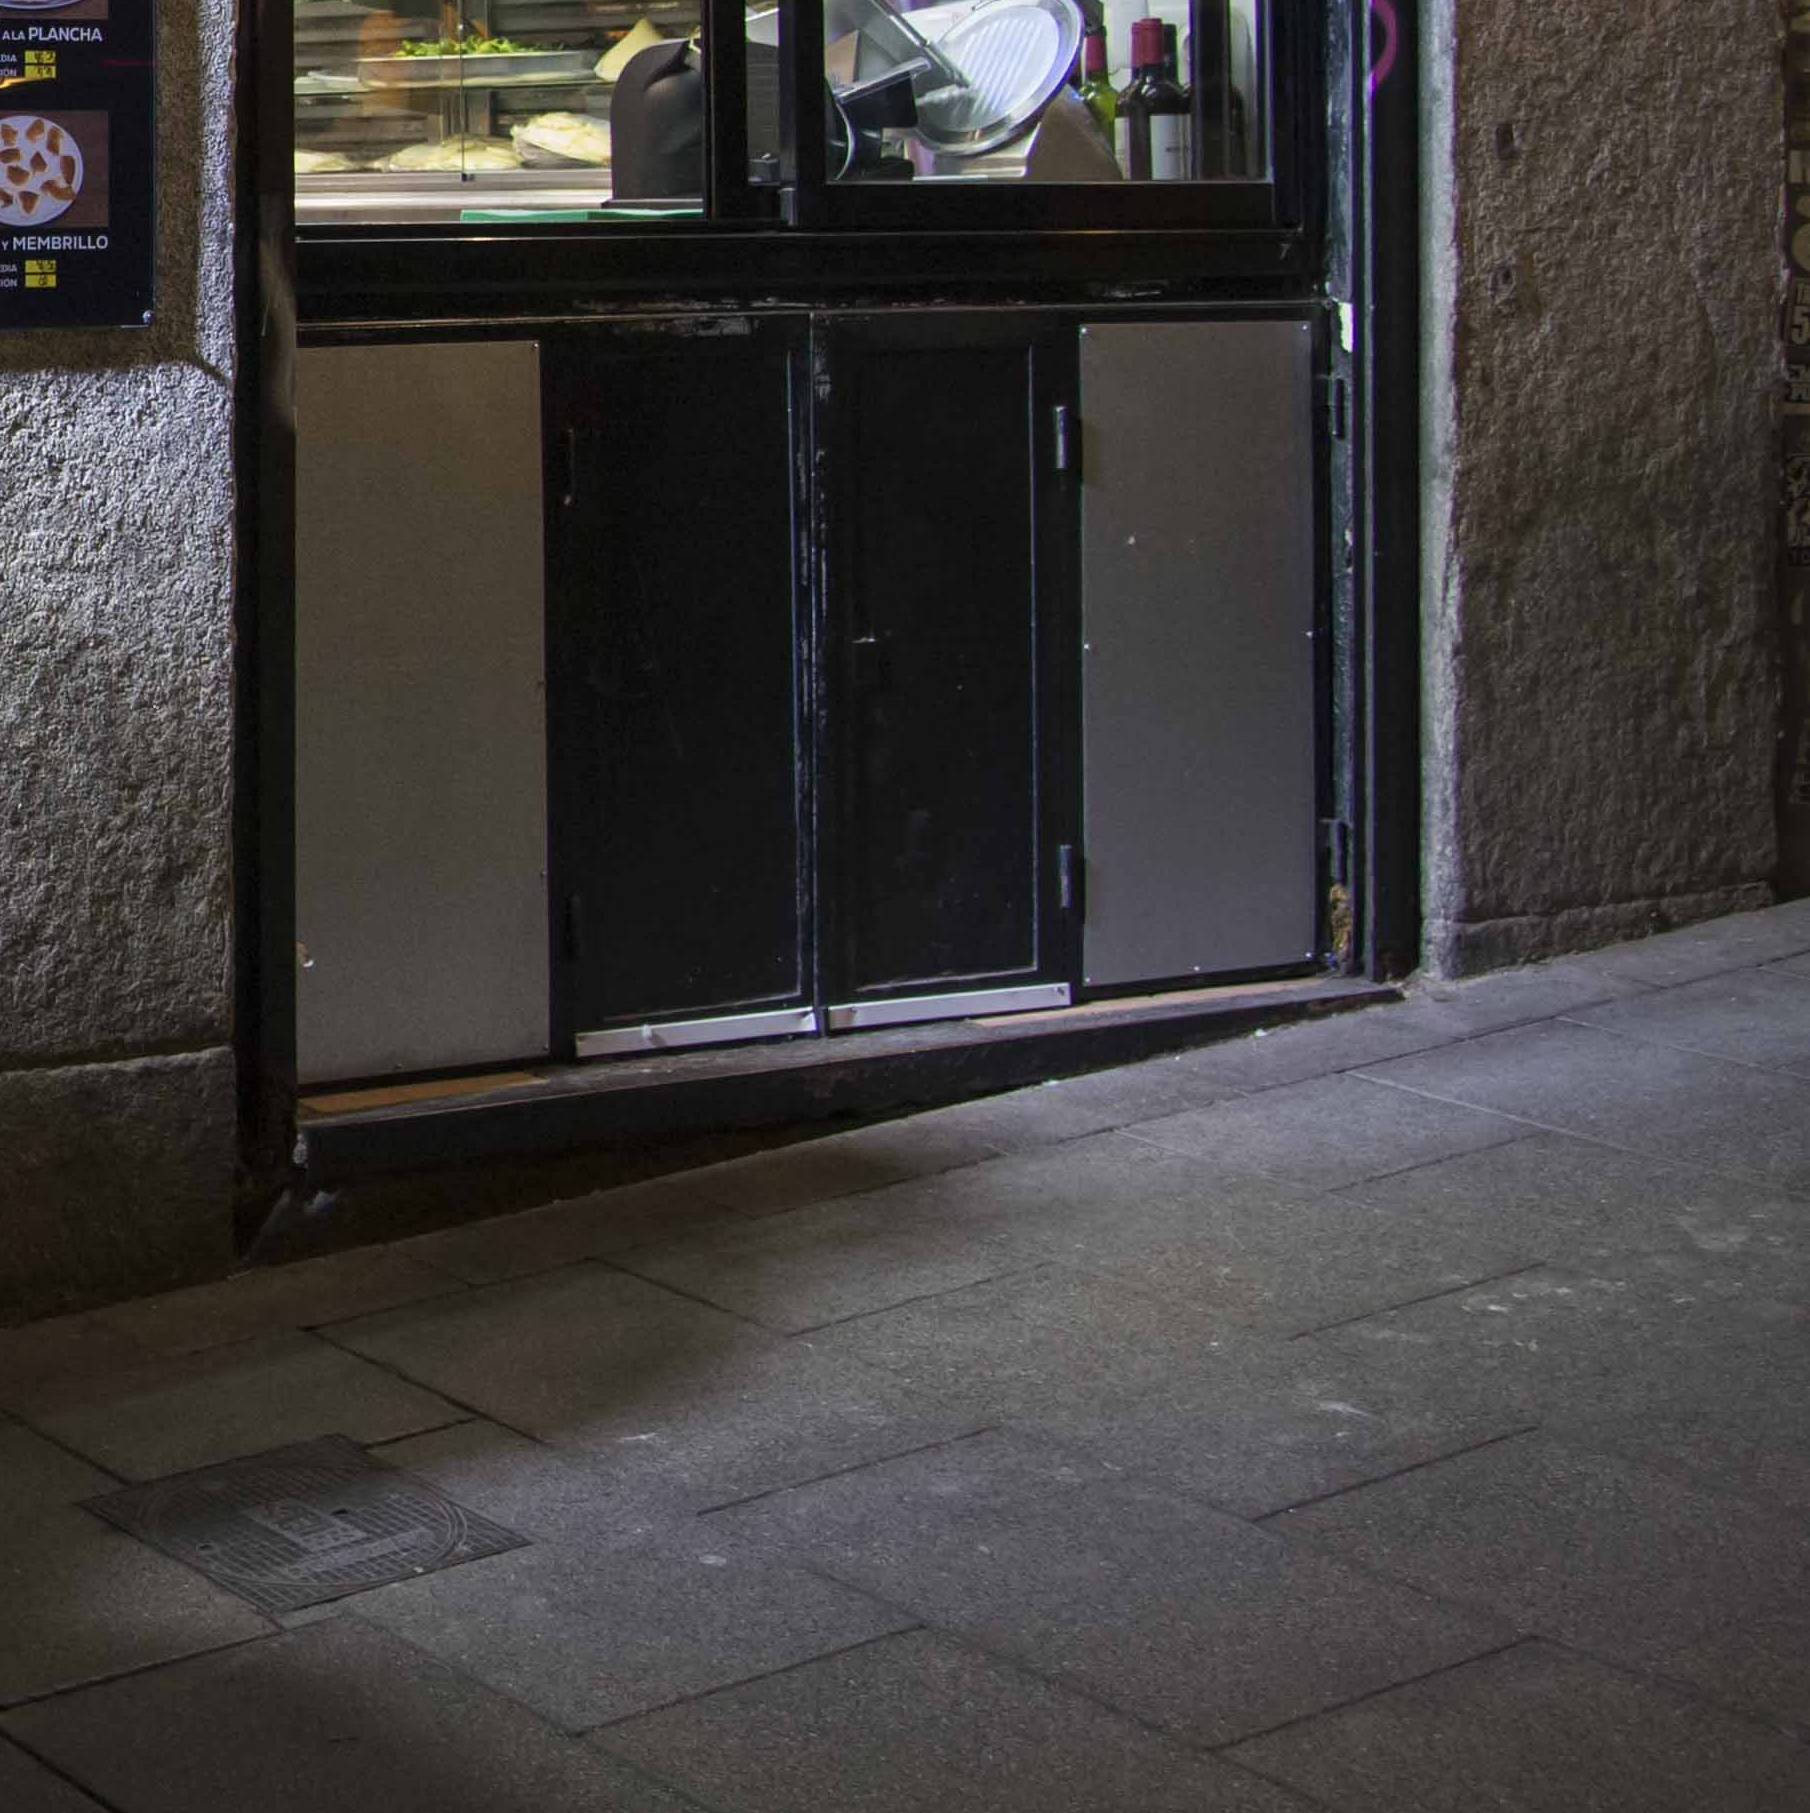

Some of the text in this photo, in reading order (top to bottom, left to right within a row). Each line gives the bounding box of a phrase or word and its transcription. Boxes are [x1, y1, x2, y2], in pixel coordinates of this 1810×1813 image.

[2, 32, 11, 41] A
[13, 32, 26, 41] LA
[28, 25, 102, 42] PLANCHA
[12, 234, 109, 252] MEMBRILLO
